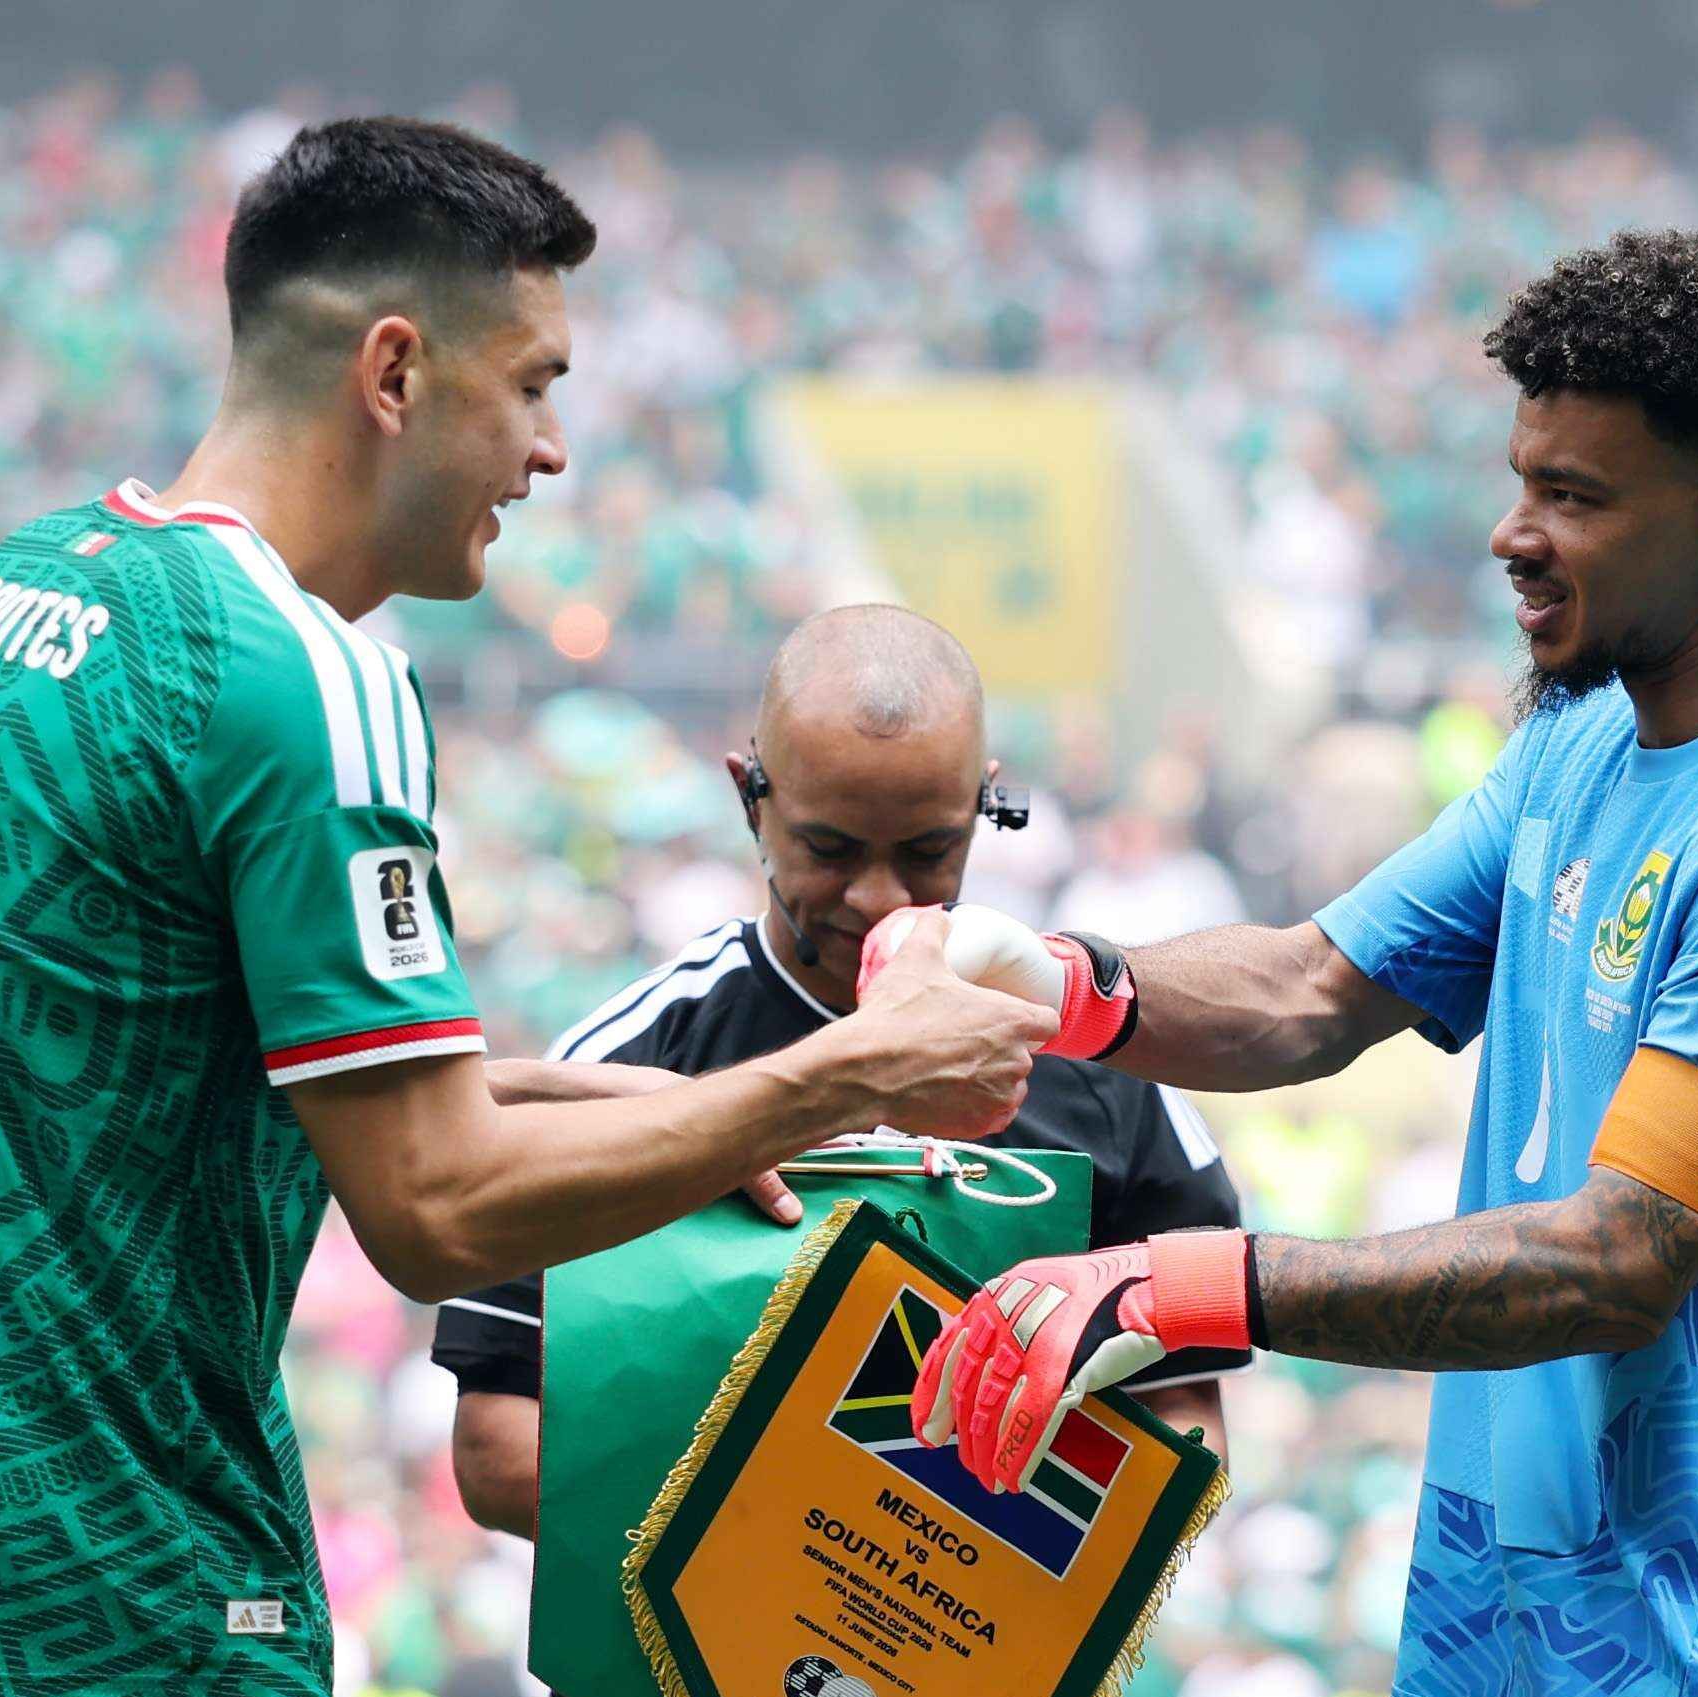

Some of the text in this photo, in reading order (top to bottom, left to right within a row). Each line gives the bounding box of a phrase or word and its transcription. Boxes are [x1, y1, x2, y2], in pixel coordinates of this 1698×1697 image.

[875, 1488, 979, 1566] MEXICO
[904, 1539, 930, 1564] VS
[802, 1544, 847, 1577] SENIOR
[882, 1594, 937, 1637] NATIONAL
[940, 1631, 971, 1658] TEAM
[804, 1508, 996, 1646] SOUTH AFRICA
[824, 1577, 933, 1652] FIFA WORLD CUP 2026
[836, 1612, 848, 1625] 11
[848, 1621, 877, 1644] JUNE
[867, 1659, 897, 1682] MEXICO
[897, 1679, 916, 1694] CITY
